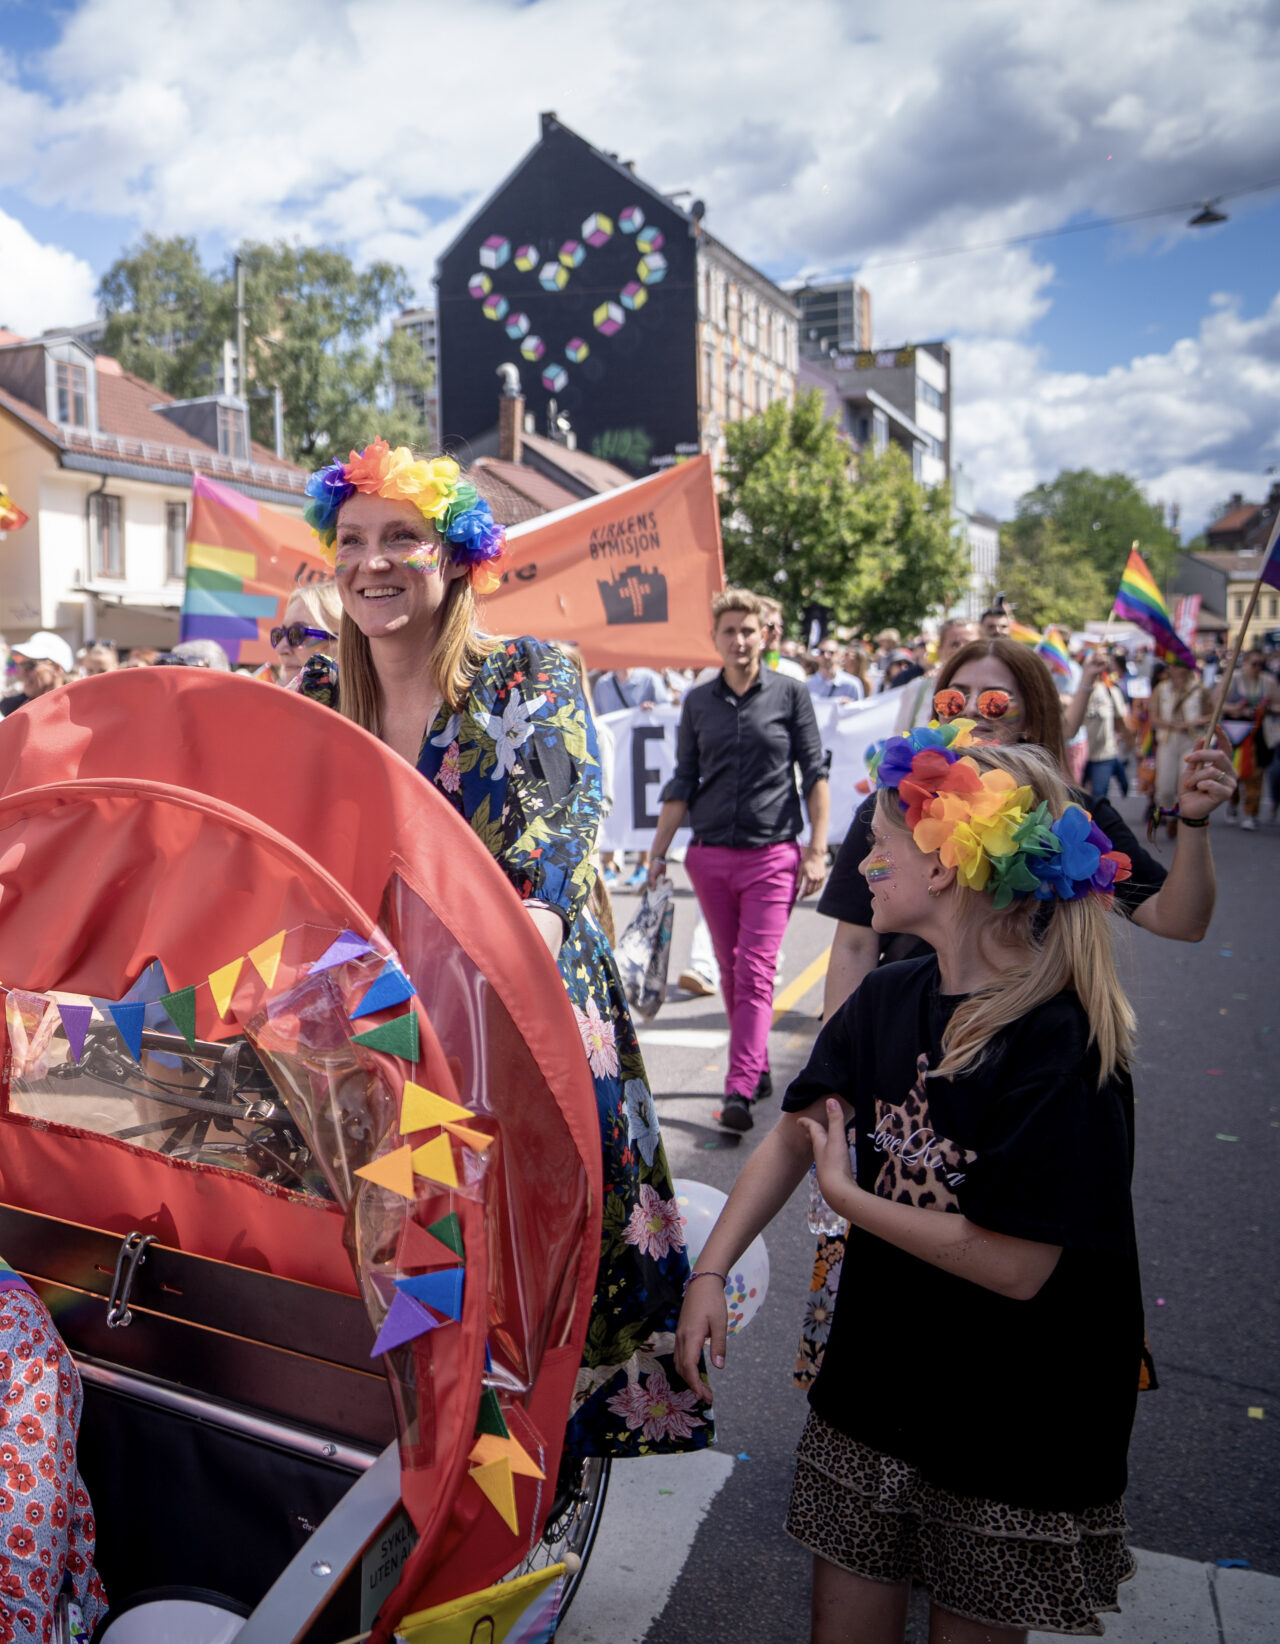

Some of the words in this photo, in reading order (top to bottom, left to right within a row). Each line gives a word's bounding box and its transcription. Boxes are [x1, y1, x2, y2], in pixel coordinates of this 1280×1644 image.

[590, 511, 658, 540] KIRKENS
[589, 531, 661, 561] BYMISJON
[370, 1555, 399, 1590] UTEN
